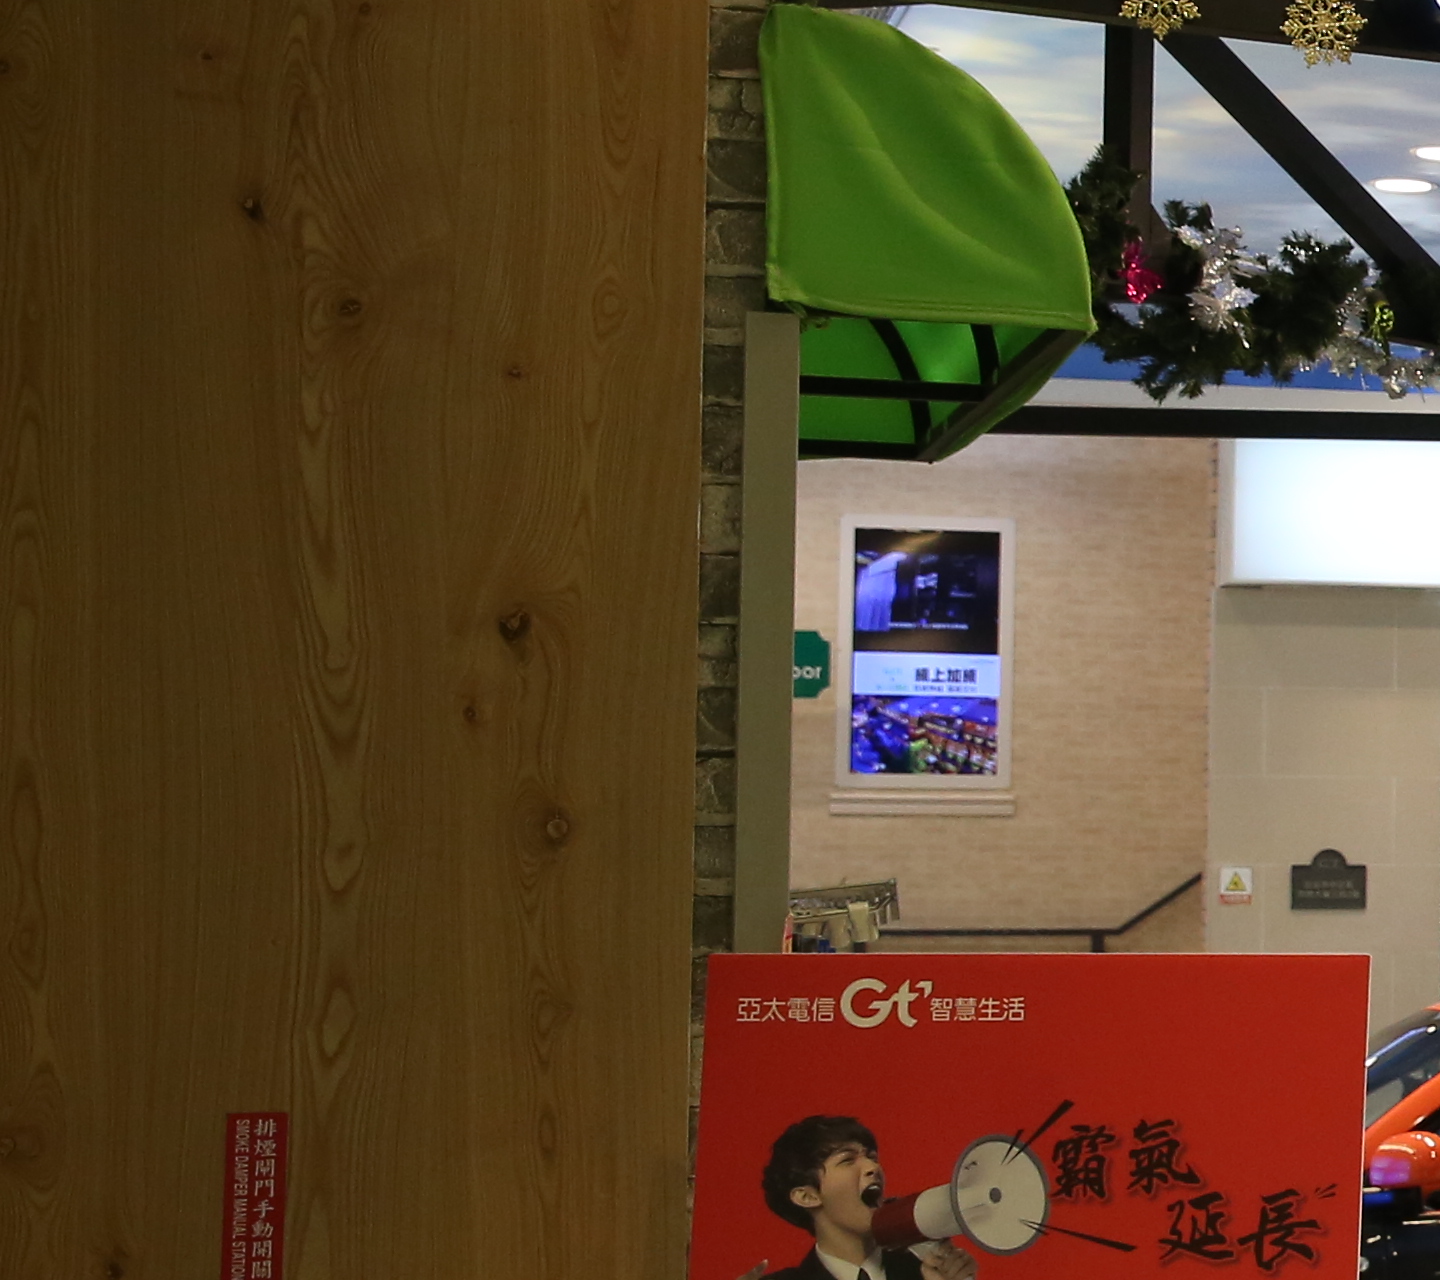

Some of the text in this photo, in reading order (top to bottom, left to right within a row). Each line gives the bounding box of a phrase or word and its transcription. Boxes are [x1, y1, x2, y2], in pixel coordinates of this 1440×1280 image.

[736, 977, 1026, 1029] 亞太電信 Gt 智慧生活
[231, 1120, 250, 1280] SMOKE DAMPER MANUAL STATION
[1050, 1119, 1200, 1201] 霸氣
[1158, 1189, 1321, 1269] 延長
